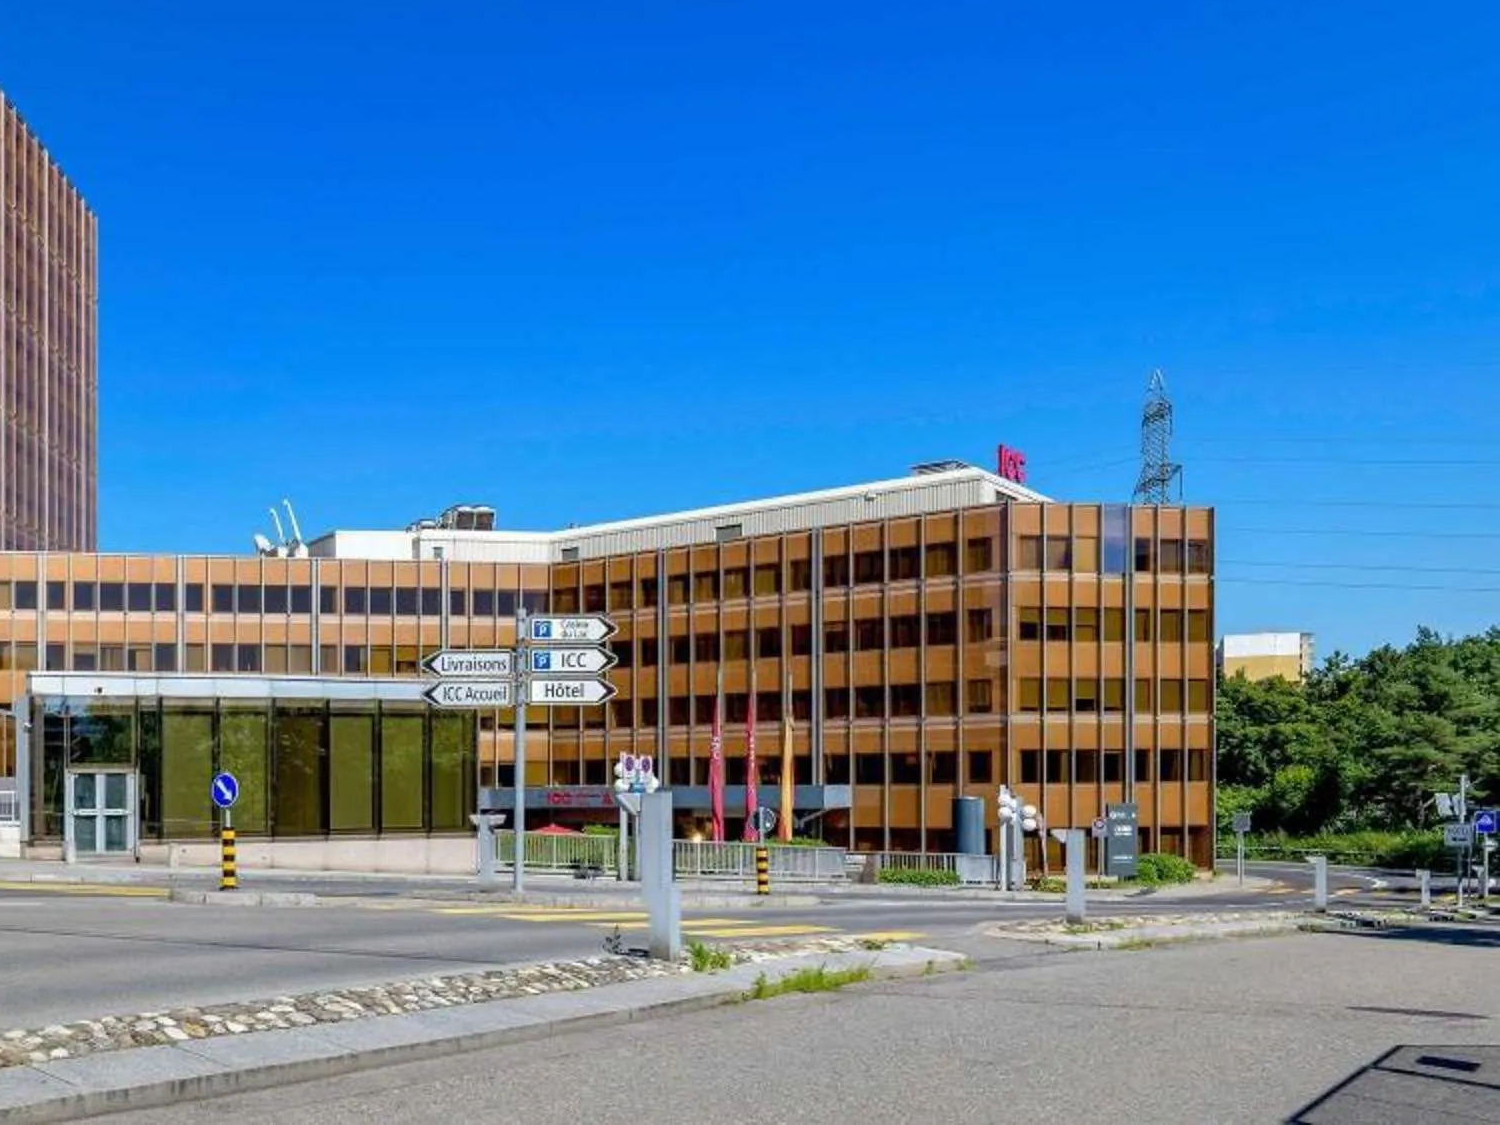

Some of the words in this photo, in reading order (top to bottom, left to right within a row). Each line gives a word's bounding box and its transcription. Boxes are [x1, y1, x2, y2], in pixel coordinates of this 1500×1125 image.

[441, 656, 507, 672] Livraisons
[561, 652, 587, 668] ICC
[443, 686, 463, 702] ICC
[465, 686, 507, 701] Accueil
[544, 682, 584, 698] Hôtel
